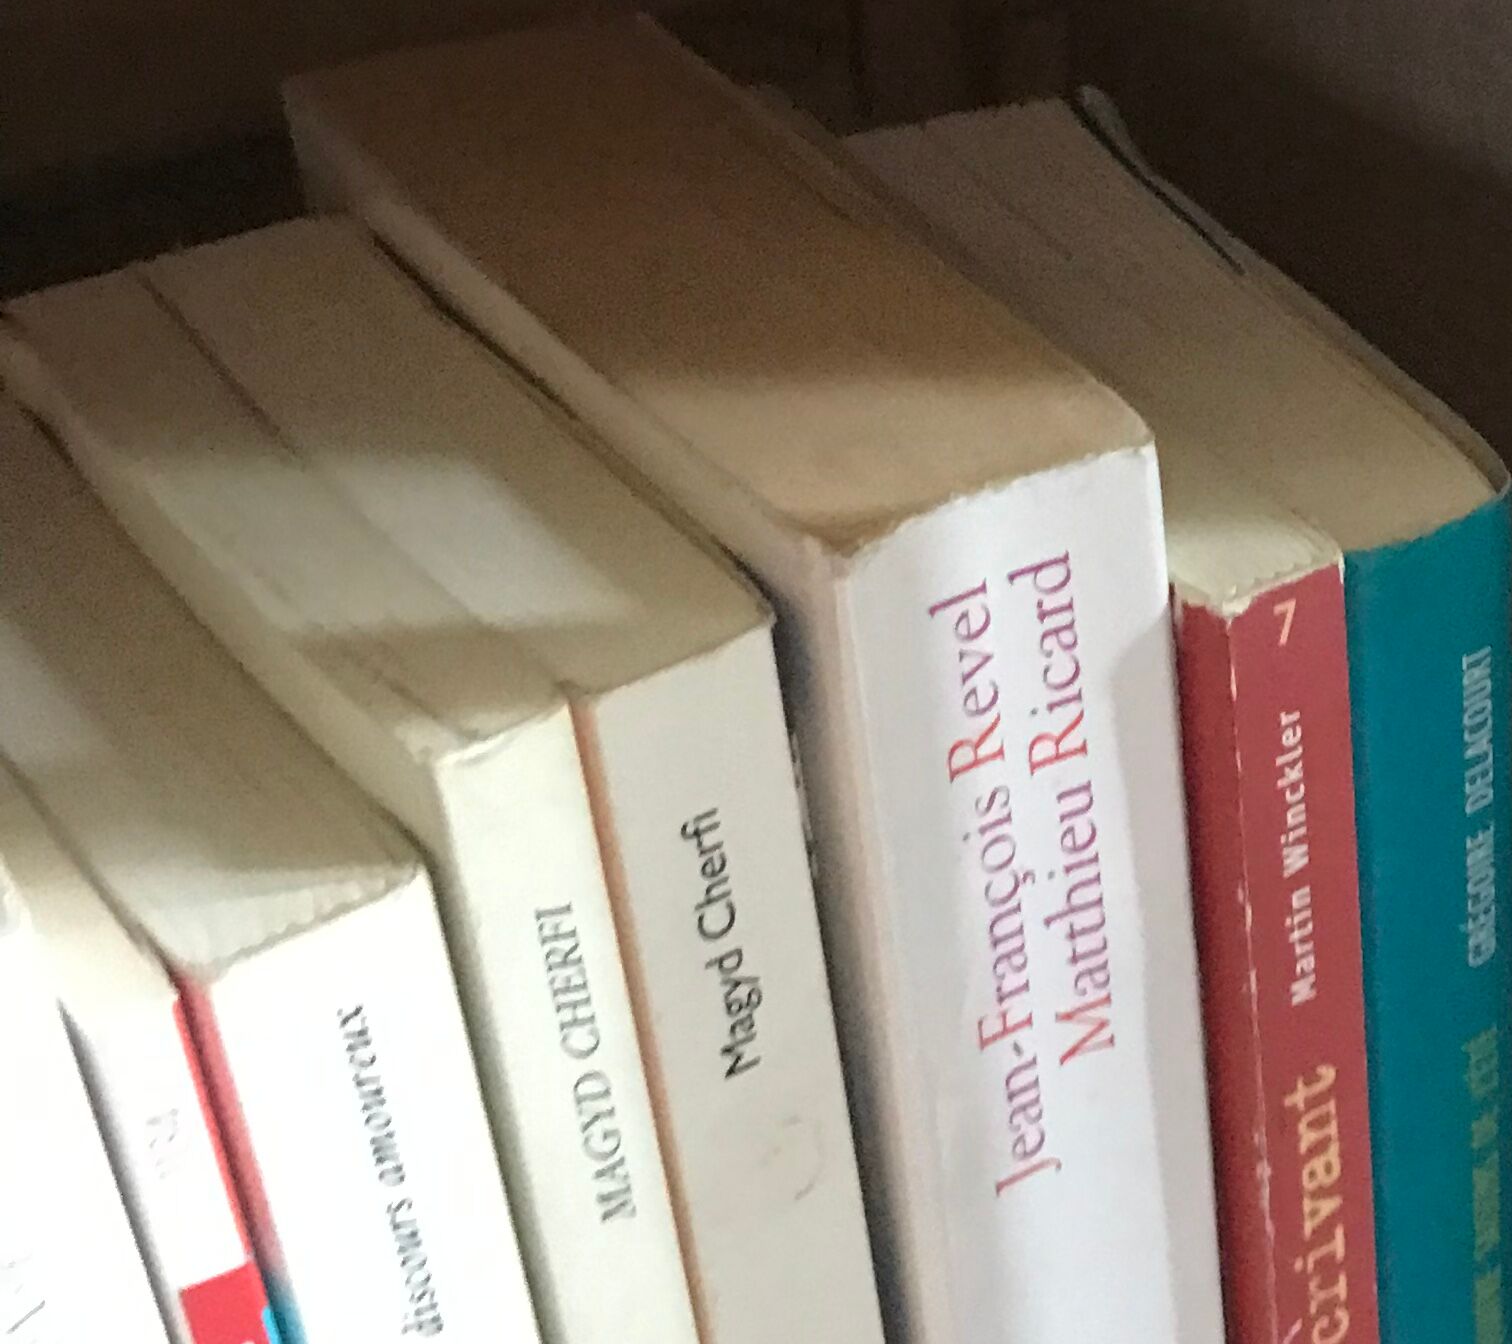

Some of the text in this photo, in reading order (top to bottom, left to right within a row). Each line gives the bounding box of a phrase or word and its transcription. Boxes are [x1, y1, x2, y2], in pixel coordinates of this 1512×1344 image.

[1009, 550, 1114, 1066] Matthieu Ricard
[1276, 710, 1317, 1006] Martin Winckler
[1462, 646, 1494, 817] DELACOURT
[680, 807, 762, 1080] Magyd Cherfi
[929, 578, 1062, 1198] Jean-François Revel
[338, 1004, 406, 1186] amoureux
[536, 902, 638, 1223] MAGYD CHERFI
[386, 1198, 445, 1337] discours
